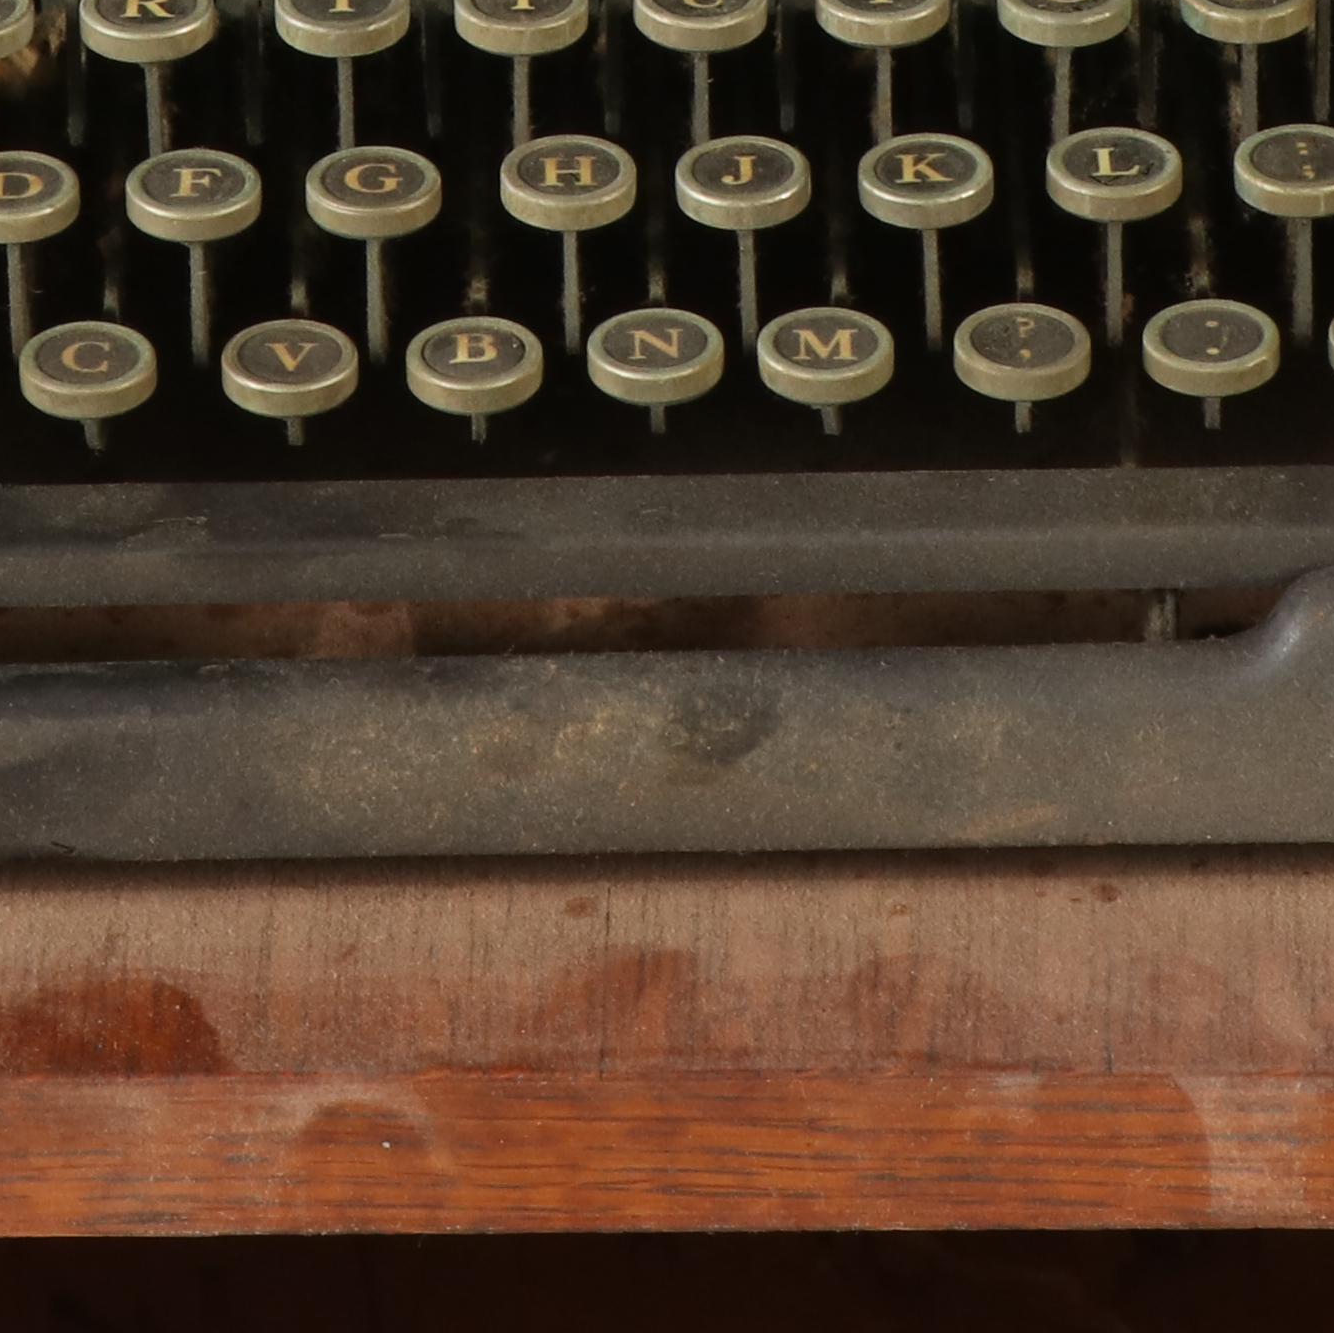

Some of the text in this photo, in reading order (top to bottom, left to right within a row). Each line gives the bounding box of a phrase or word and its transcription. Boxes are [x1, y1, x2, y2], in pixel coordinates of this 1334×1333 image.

[344, 163, 403, 192] G
[539, 155, 597, 186] H
[720, 155, 756, 185] J
[894, 153, 953, 184] K
[1091, 147, 1141, 177] L
[170, 167, 222, 198] F
[1015, 317, 1035, 338] ?
[60, 341, 109, 373] C
[266, 343, 317, 372] V
[449, 333, 498, 364] B
[628, 328, 684, 359] N
[792, 329, 859, 361] M
